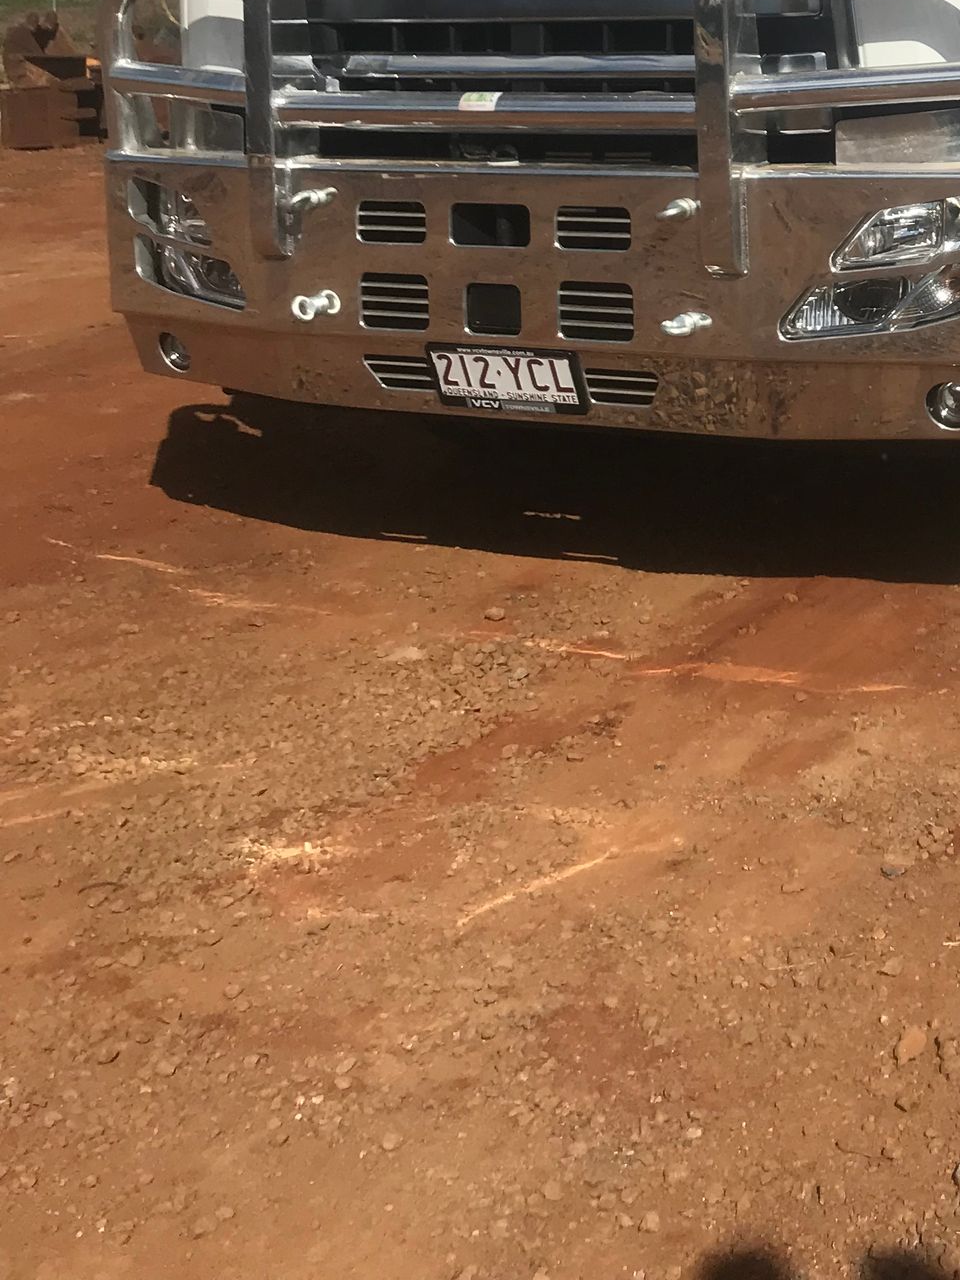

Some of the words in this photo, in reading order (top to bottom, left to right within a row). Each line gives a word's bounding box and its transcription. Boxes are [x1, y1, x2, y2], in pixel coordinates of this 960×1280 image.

[471, 398, 500, 409] VCV
[506, 391, 549, 402] SUNSHINE
[551, 394, 578, 404] STATE
